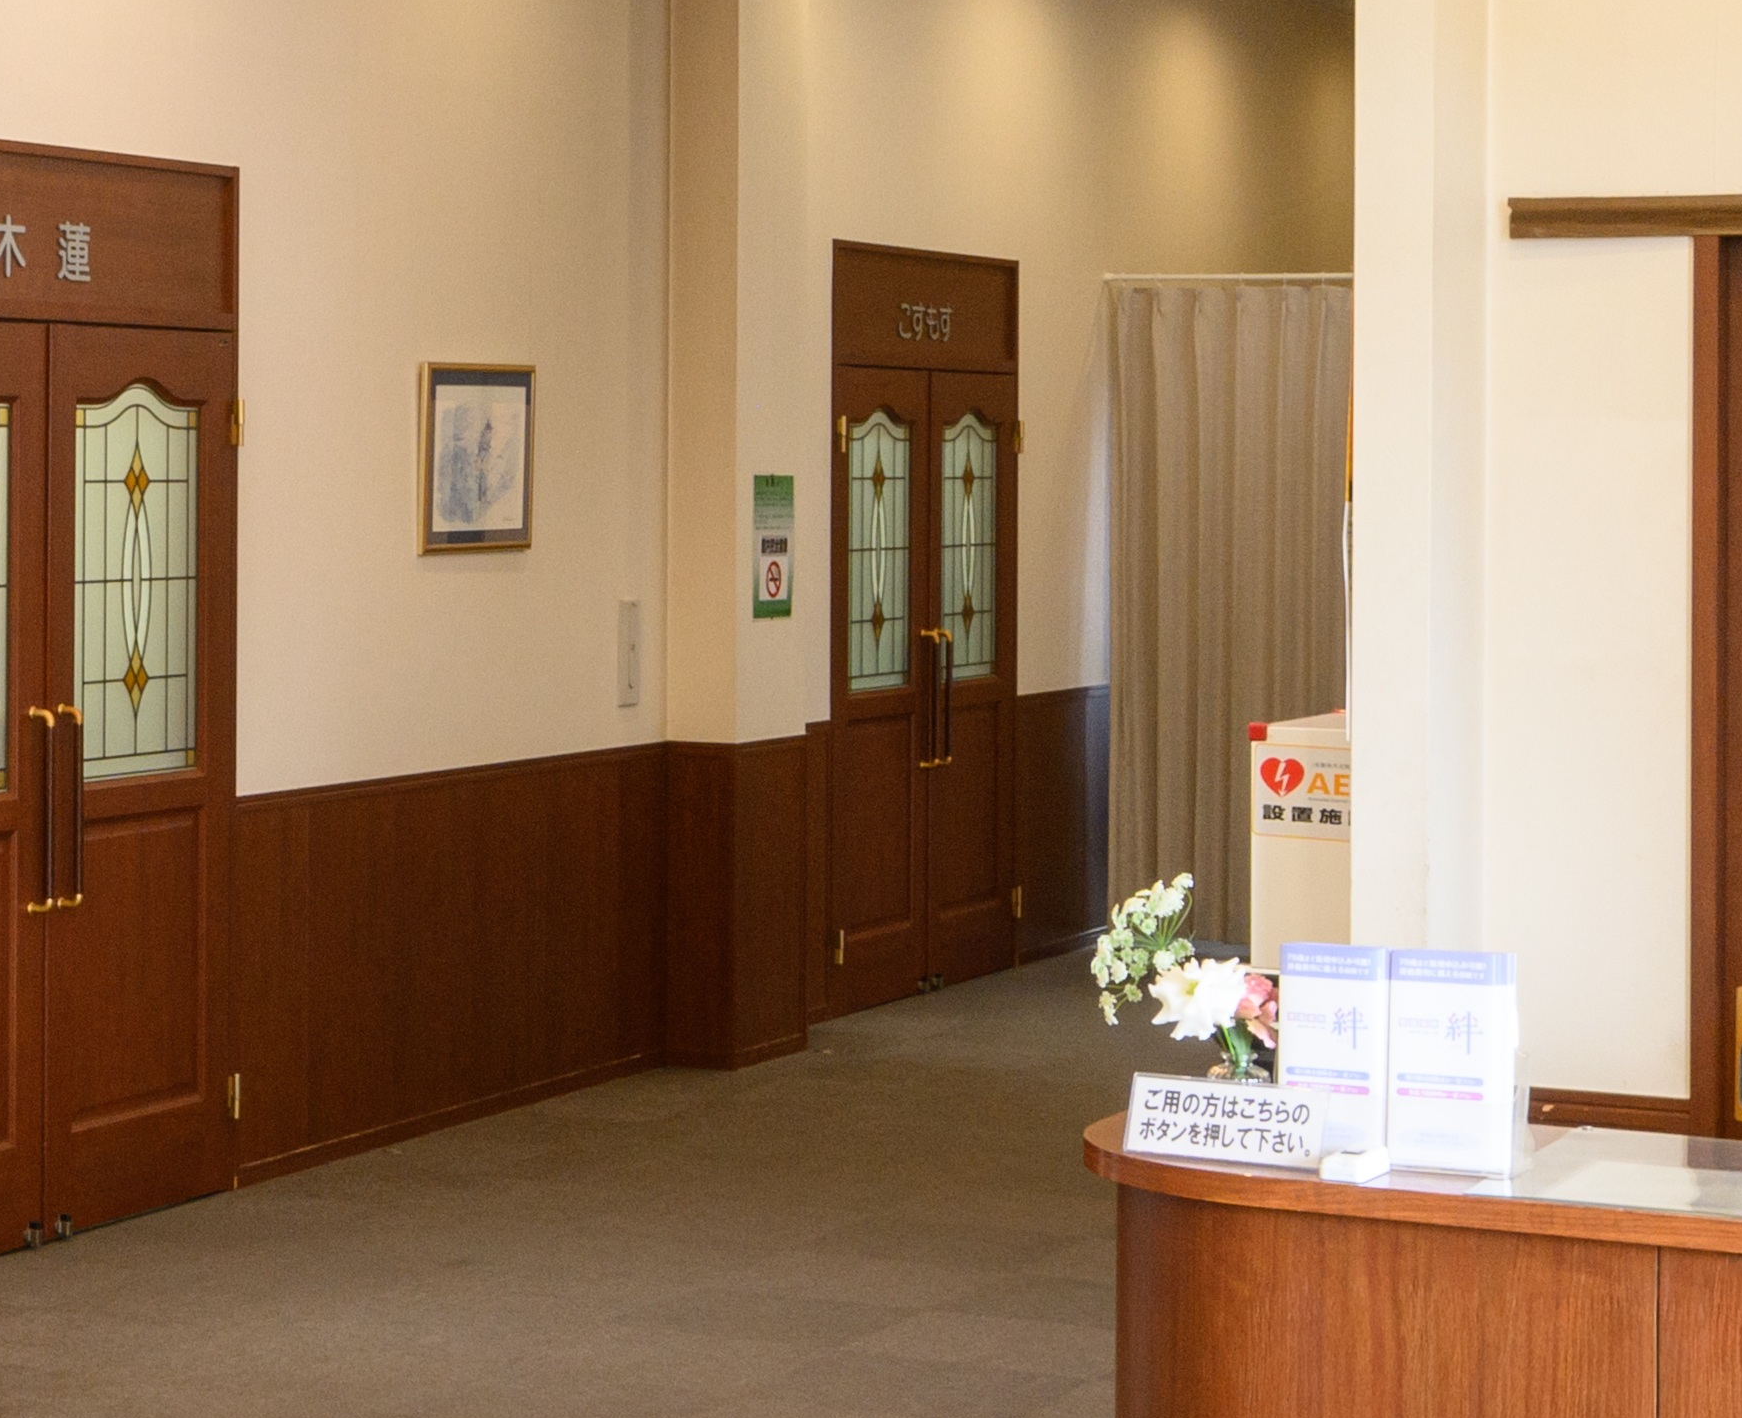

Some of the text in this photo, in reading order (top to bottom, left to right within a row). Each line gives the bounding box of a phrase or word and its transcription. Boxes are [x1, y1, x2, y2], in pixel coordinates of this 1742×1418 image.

[1306, 772, 1350, 796] AE
[1262, 804, 1350, 827] 設置施
[1330, 1006, 1369, 1050] 絆
[1444, 1011, 1483, 1055] 絆
[1144, 1088, 1310, 1125] ご用の方はこちらの
[1139, 1117, 1311, 1158] ボタンを押して下さい。
